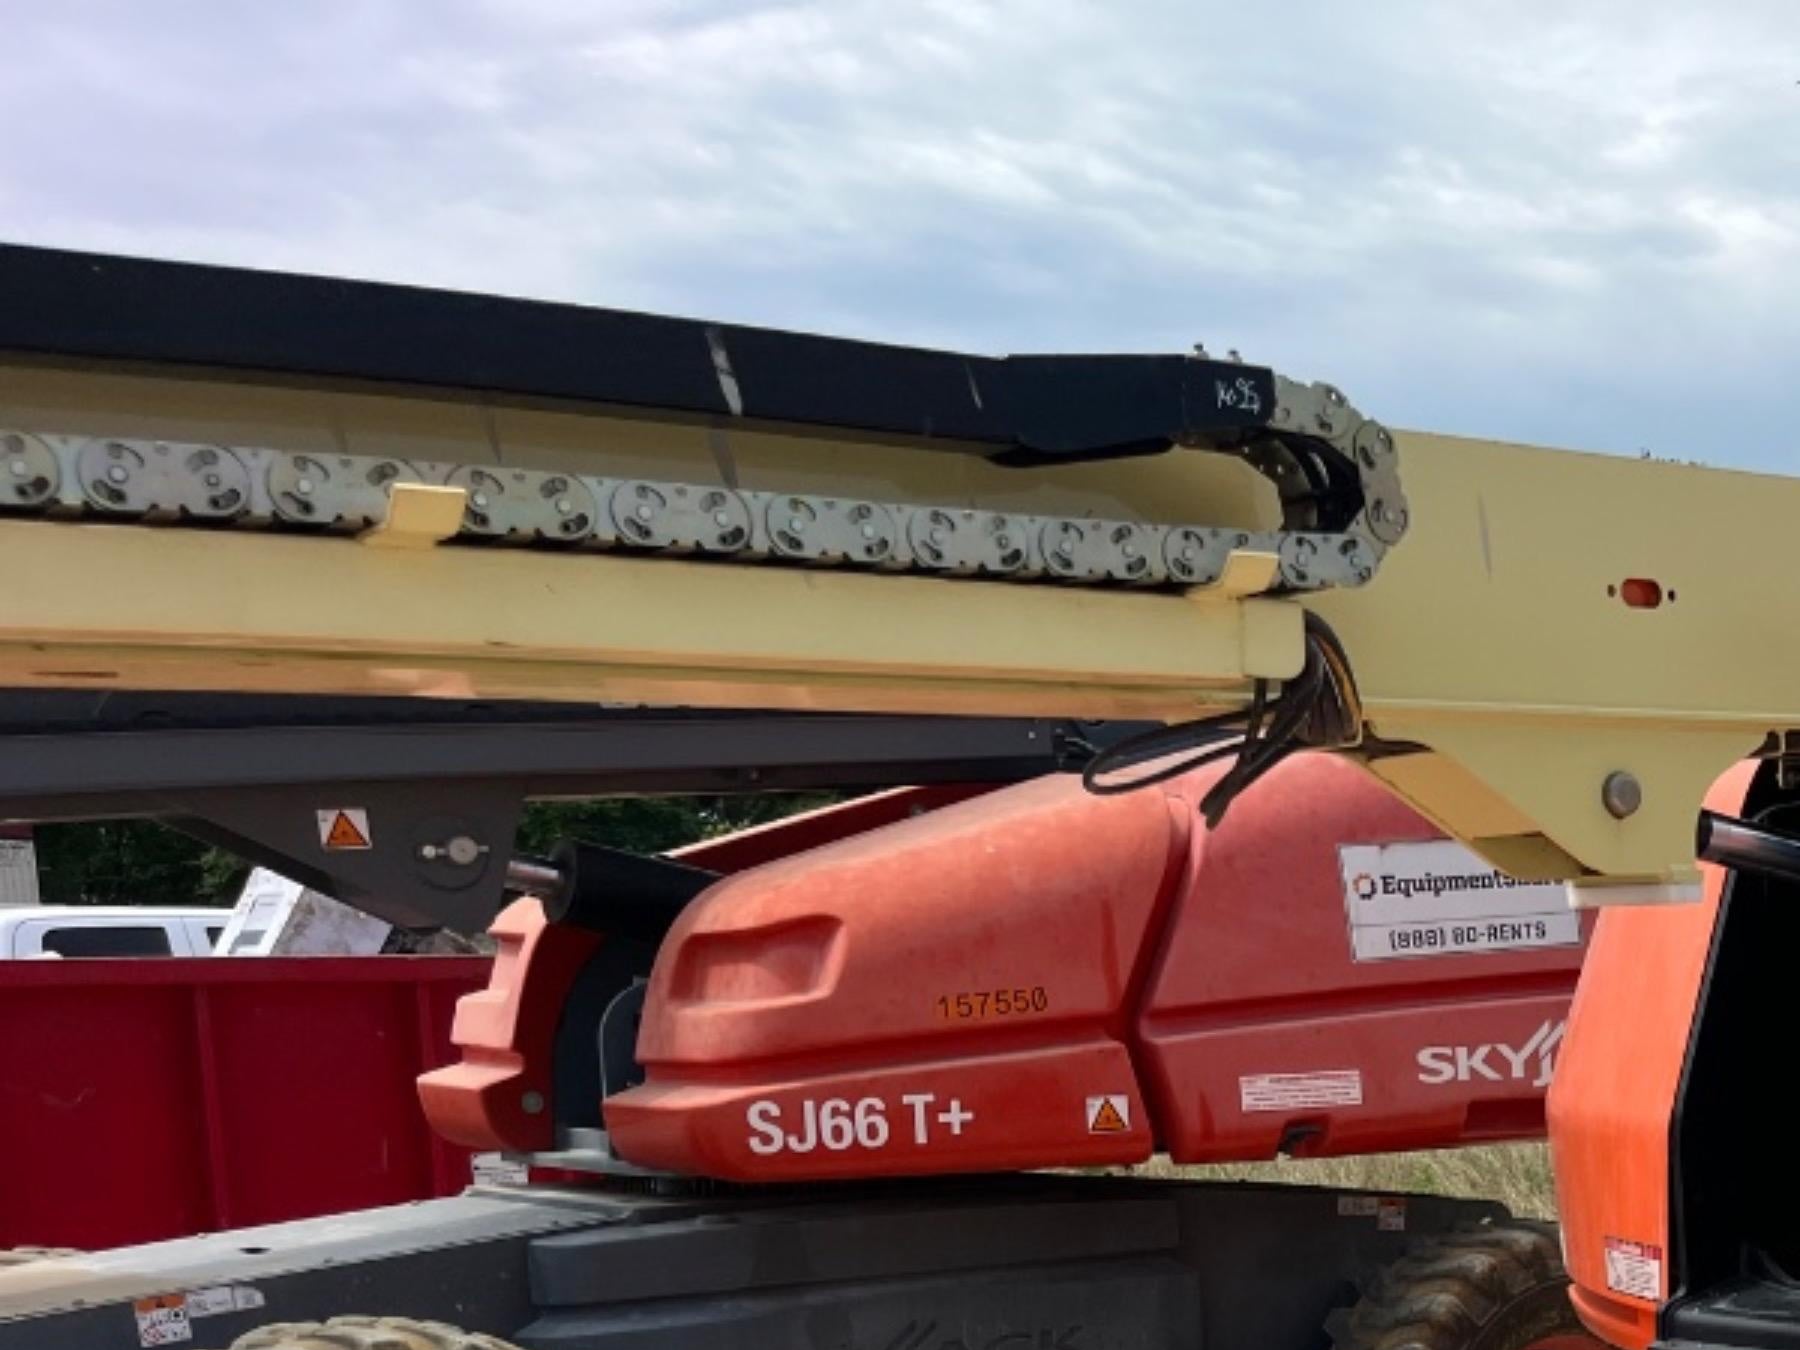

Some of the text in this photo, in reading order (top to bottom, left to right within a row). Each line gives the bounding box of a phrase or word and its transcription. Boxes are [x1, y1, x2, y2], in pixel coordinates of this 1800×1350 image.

[1389, 920, 1547, 951] (888) 80-RENTS
[938, 986, 1048, 1019] 157550
[1416, 1019, 1568, 1088] SKYJ
[747, 1091, 975, 1156] SJ66 T+
